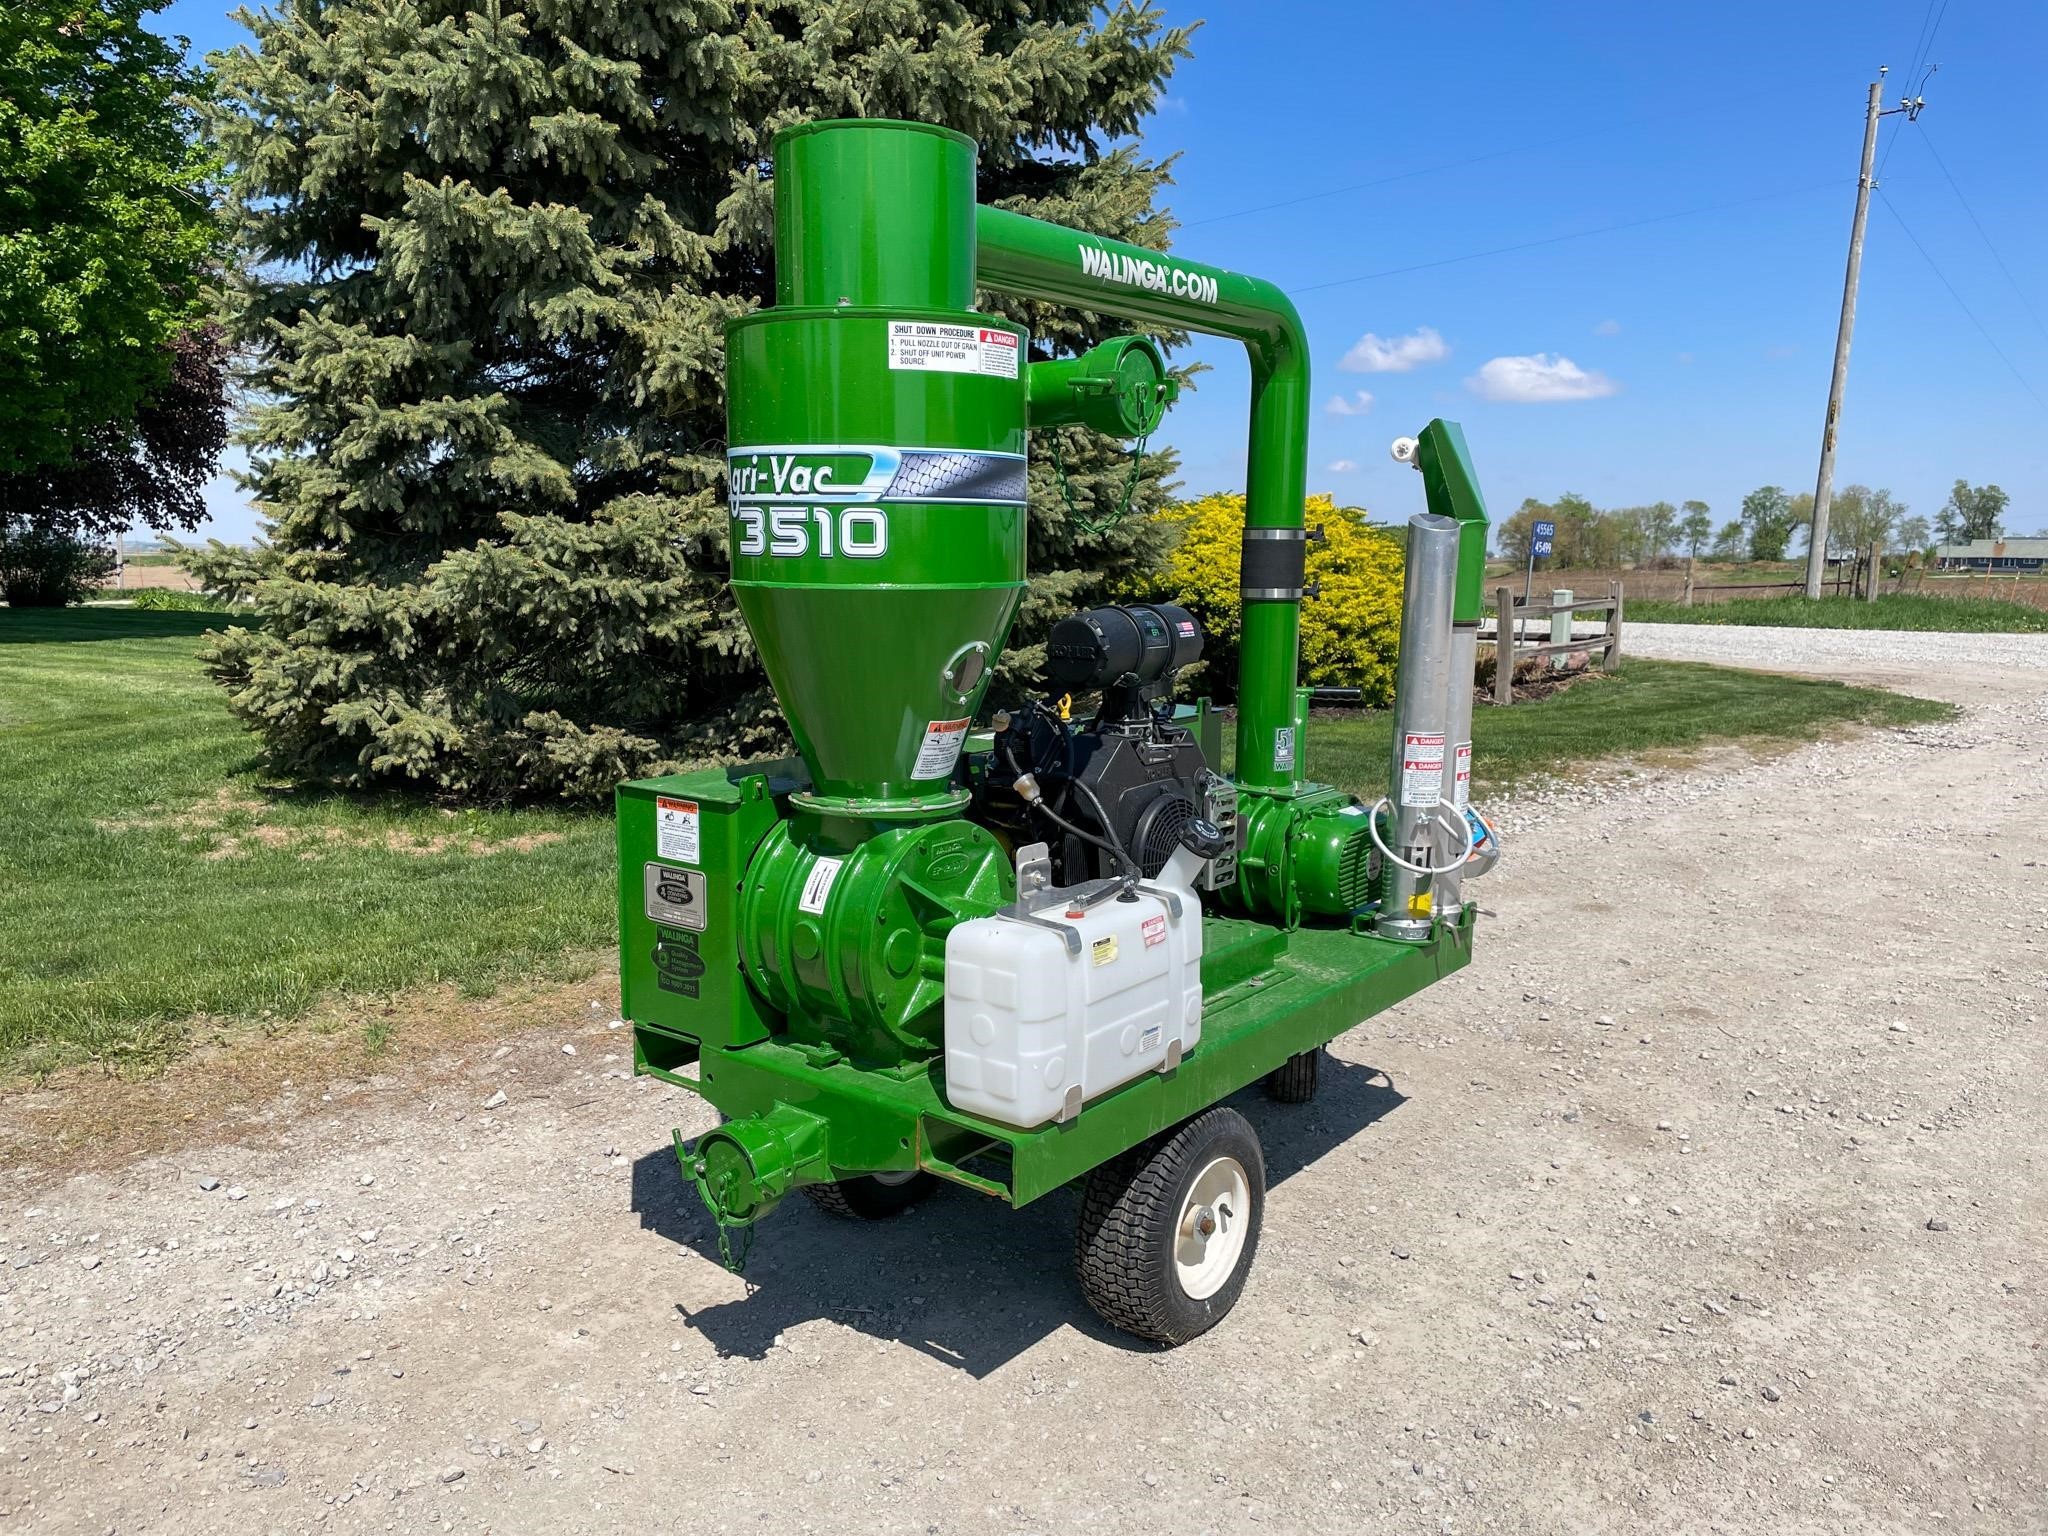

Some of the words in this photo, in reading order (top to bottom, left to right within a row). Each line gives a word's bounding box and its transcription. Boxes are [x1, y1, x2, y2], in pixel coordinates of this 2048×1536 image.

[894, 325, 913, 334] SHUT
[916, 327, 937, 336] DOWN
[940, 328, 975, 338] PROCEDURE
[890, 339, 897, 347] 1.
[900, 339, 916, 347] PULL
[917, 339, 939, 348] NOZZLE
[941, 340, 953, 349] OUT
[954, 340, 961, 349] OF
[962, 341, 978, 351] GRAIN
[993, 333, 1016, 346] DANGER
[890, 348, 897, 356] 2.
[900, 348, 917, 357] SHUT
[918, 349, 931, 358] OFF
[931, 350, 945, 358] UNIT
[946, 351, 966, 359] POWER
[728, 454, 833, 518] gri-Vac
[739, 506, 889, 558] 3510
[1536, 523, 1554, 536] 45565
[1534, 541, 1552, 554] 45499
[667, 800, 694, 811] WARNING
[662, 870, 686, 882] WALINGA
[661, 929, 694, 945] WALINGA
